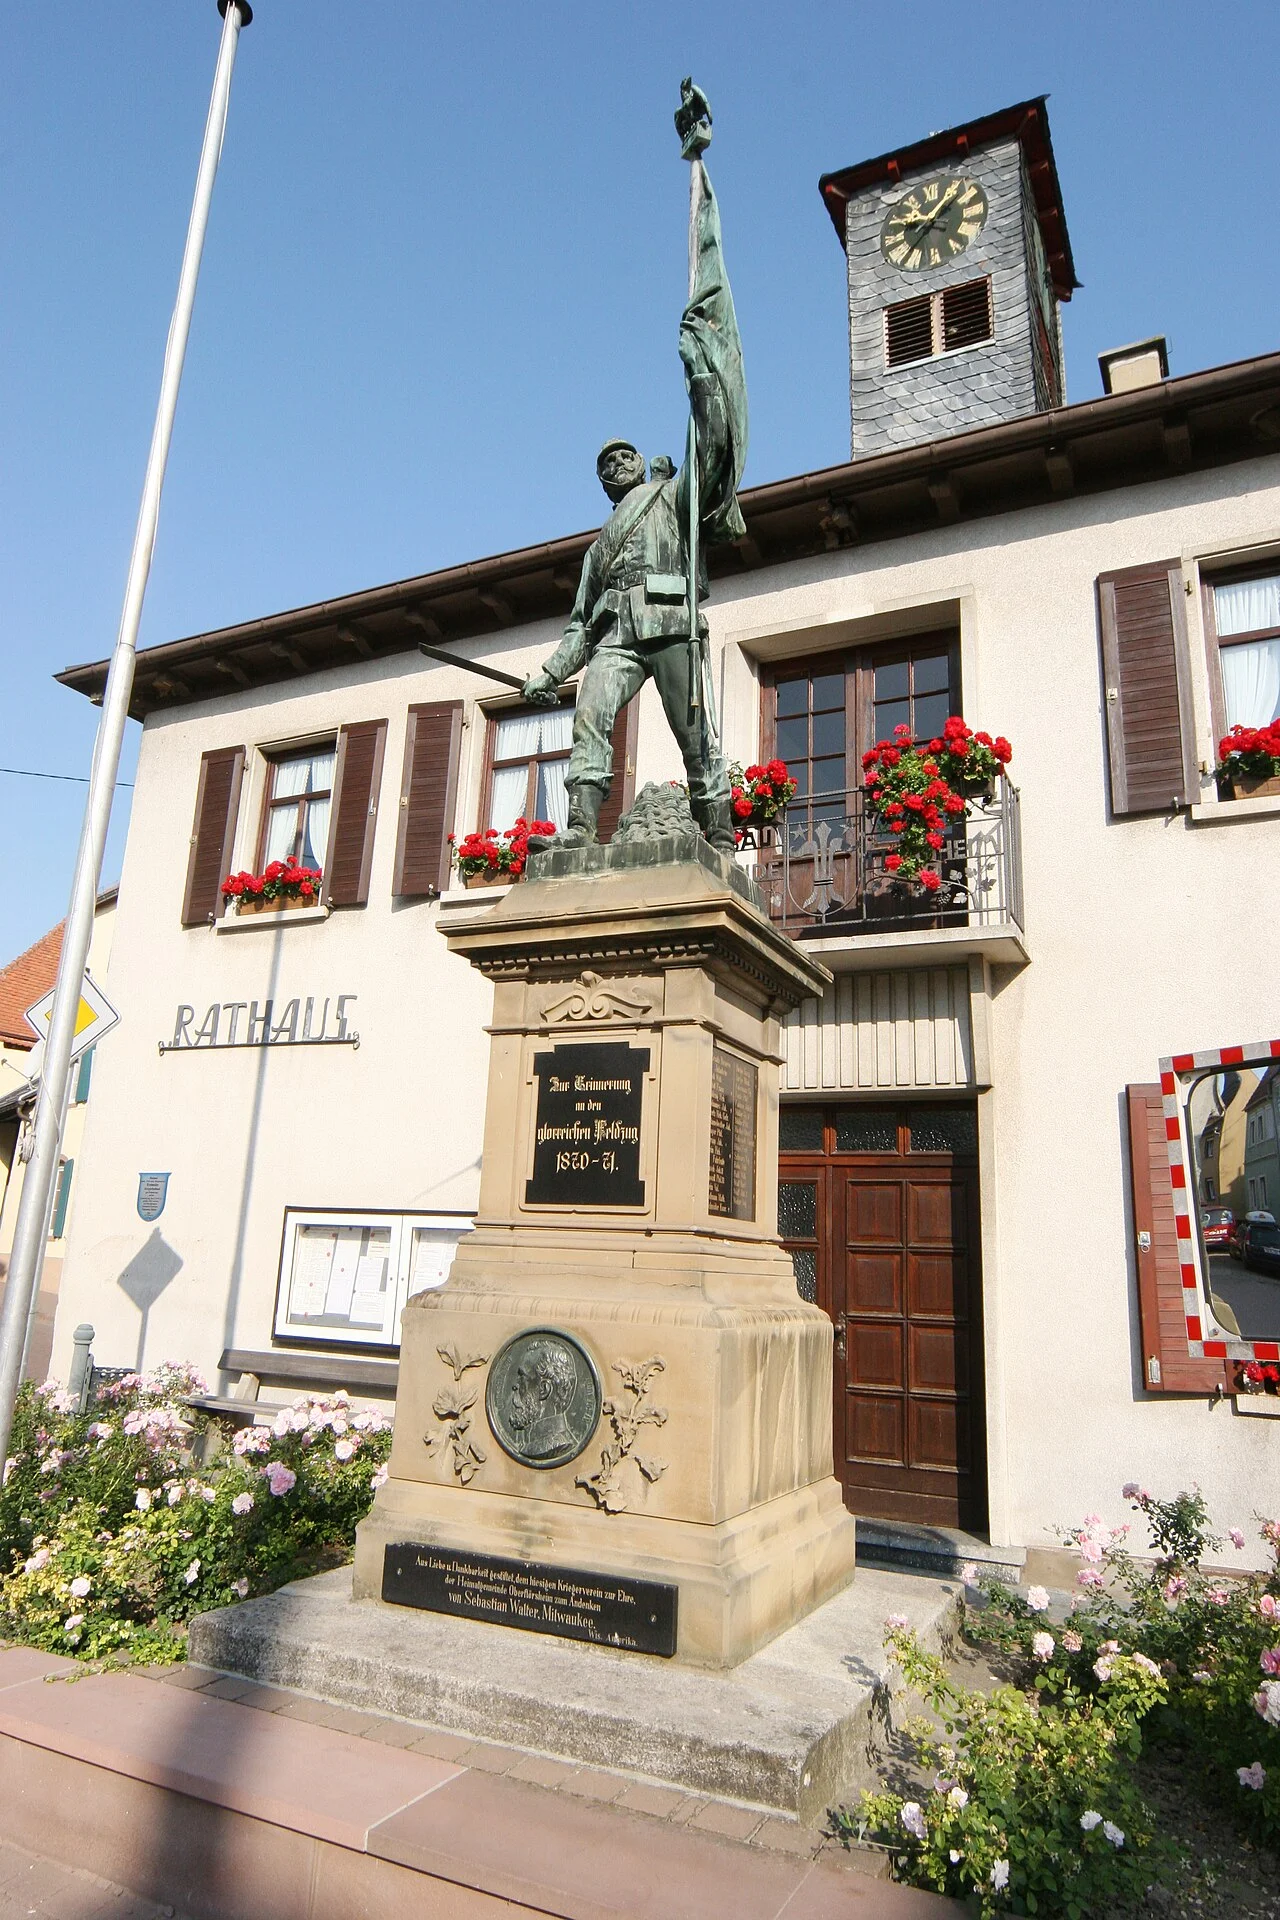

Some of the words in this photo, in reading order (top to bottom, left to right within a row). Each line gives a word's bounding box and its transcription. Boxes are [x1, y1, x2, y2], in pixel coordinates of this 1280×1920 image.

[922, 182, 939, 203] XII
[169, 995, 358, 1047] RATHAUS
[549, 1076, 570, 1092] Zur
[574, 1074, 632, 1095] Erinnerung
[575, 1102, 585, 1111] an
[587, 1099, 602, 1111] den
[537, 1120, 591, 1145] glorreichen
[594, 1118, 639, 1145] Feldzug
[415, 1554, 427, 1567] Aus
[429, 1556, 445, 1570] Liebe
[452, 1560, 489, 1577] Dankbarkeit
[529, 1575, 557, 1592] hiesigen
[557, 1579, 603, 1598] Kriegerverein
[604, 1591, 616, 1600] zur
[444, 1574, 455, 1585] der
[457, 1575, 508, 1595] Heimatgemeinde
[568, 1596, 602, 1612] Andenken
[448, 1592, 462, 1604] von
[463, 1590, 508, 1613] Sebastian
